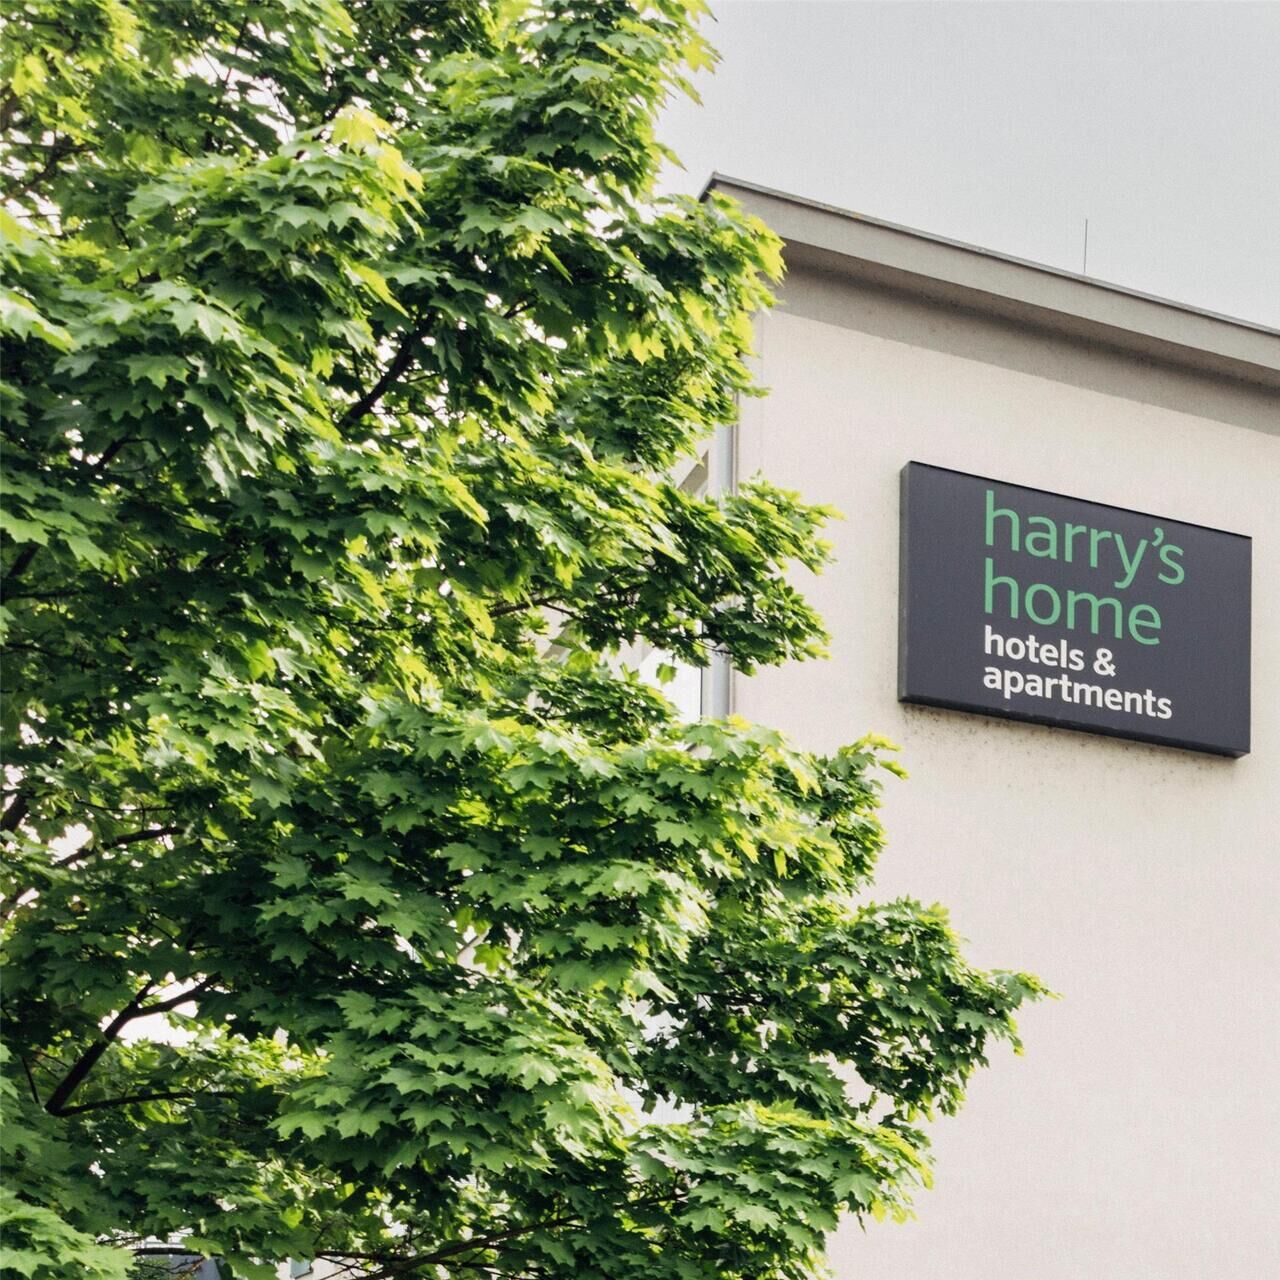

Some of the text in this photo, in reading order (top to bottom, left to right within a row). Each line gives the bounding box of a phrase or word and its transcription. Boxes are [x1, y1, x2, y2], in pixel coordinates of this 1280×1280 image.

[985, 489, 1185, 589] harry's
[984, 557, 1162, 645] home
[984, 625, 1117, 677] hotels &
[983, 665, 1173, 720] apartments
